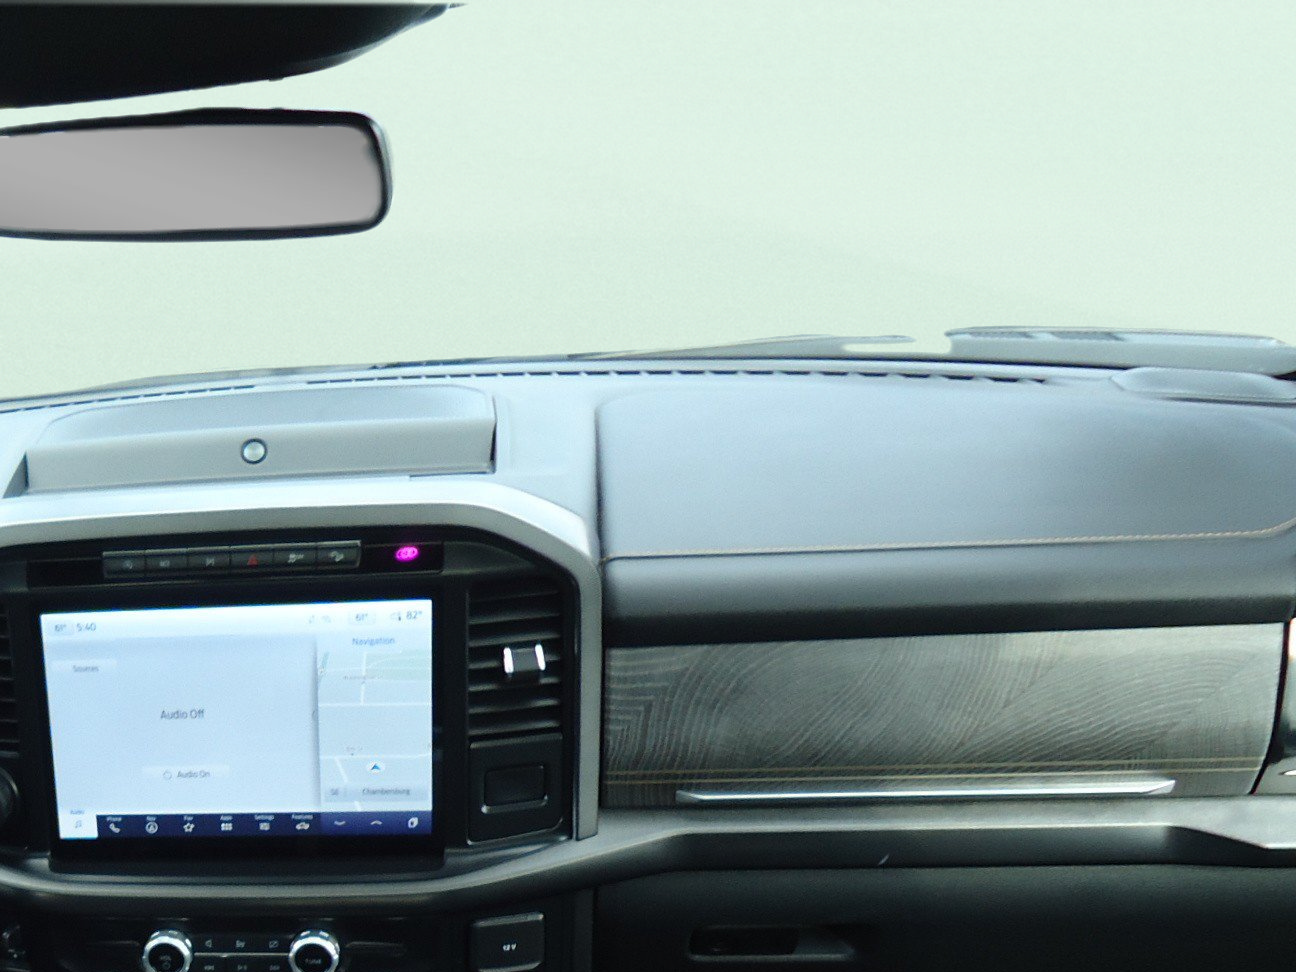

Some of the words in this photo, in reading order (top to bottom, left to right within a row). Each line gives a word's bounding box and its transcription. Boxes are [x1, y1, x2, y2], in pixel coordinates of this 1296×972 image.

[76, 622, 97, 632] 5:40
[351, 637, 396, 646] Navigation
[160, 709, 188, 720] Audio
[189, 708, 205, 719] Off
[176, 770, 198, 779] Audio
[198, 770, 211, 778] On
